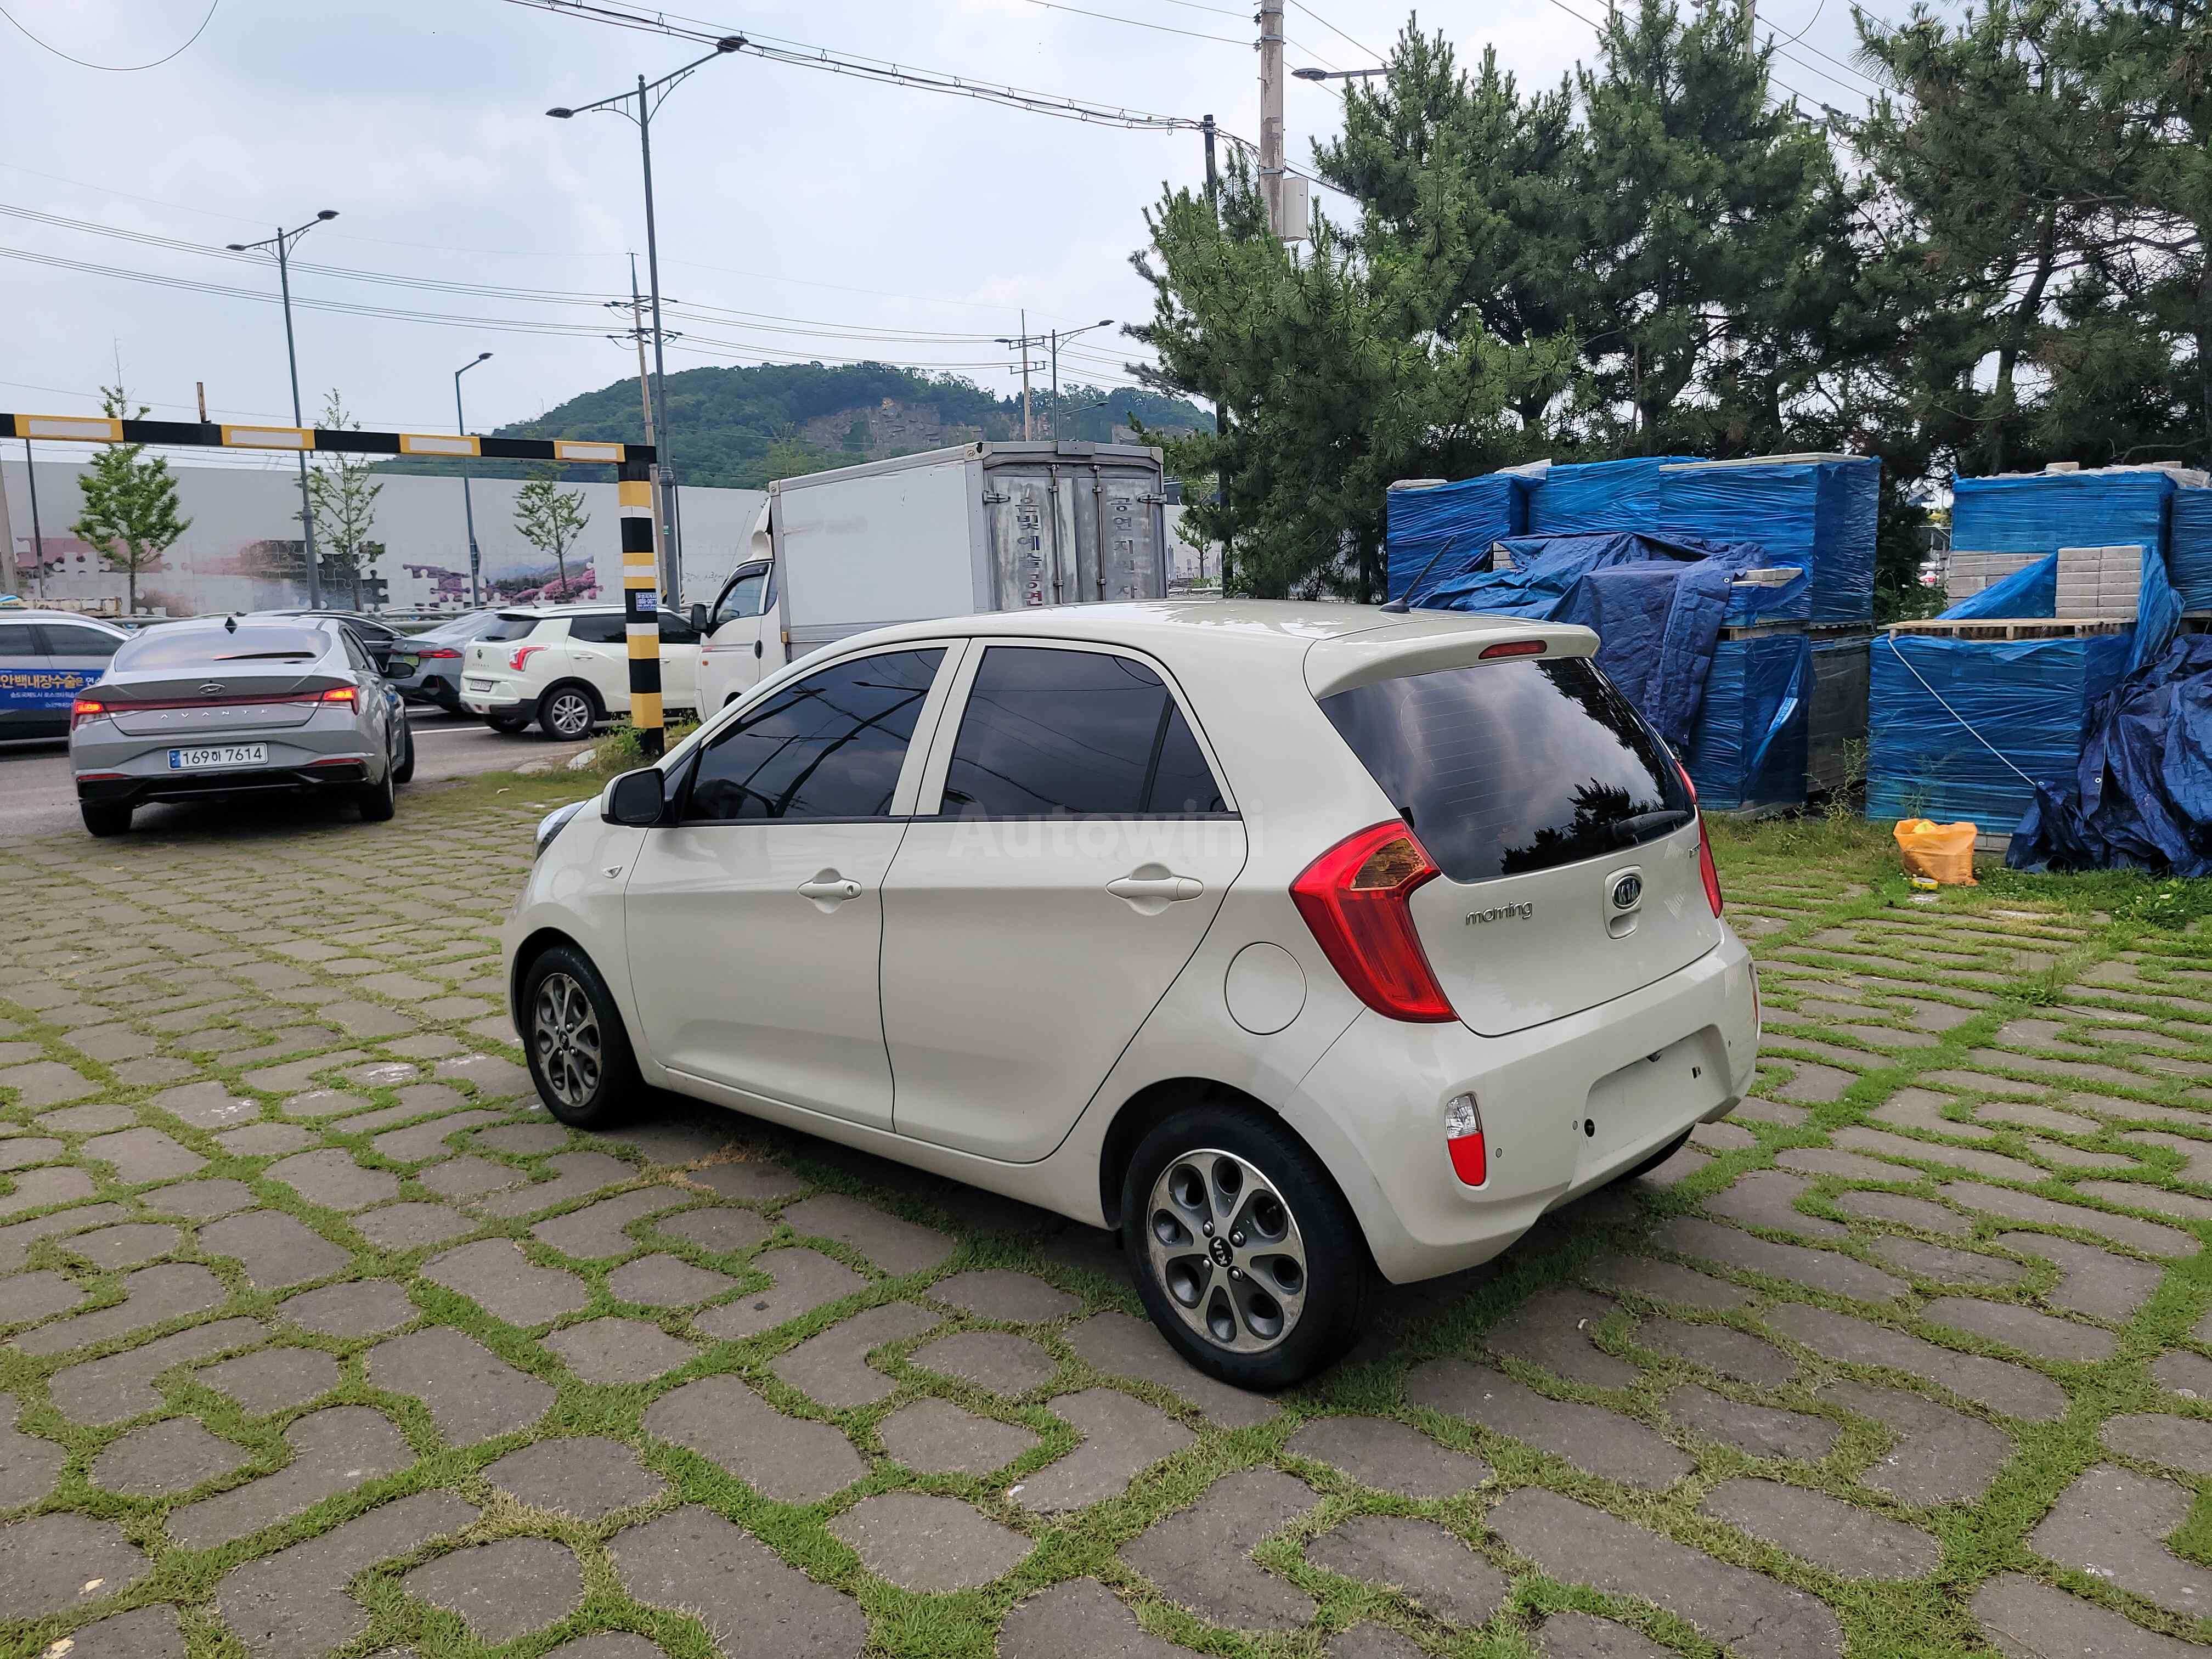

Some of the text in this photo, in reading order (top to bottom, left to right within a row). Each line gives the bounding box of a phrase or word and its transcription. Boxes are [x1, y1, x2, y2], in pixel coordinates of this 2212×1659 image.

[0, 673, 83, 689] 안백내장수술은
[160, 709, 268, 720] AVANTE
[225, 747, 262, 762] 7614
[1617, 879, 1639, 904] KIA
[1465, 900, 1533, 926] morning
[1214, 1239, 1227, 1265] KIA
